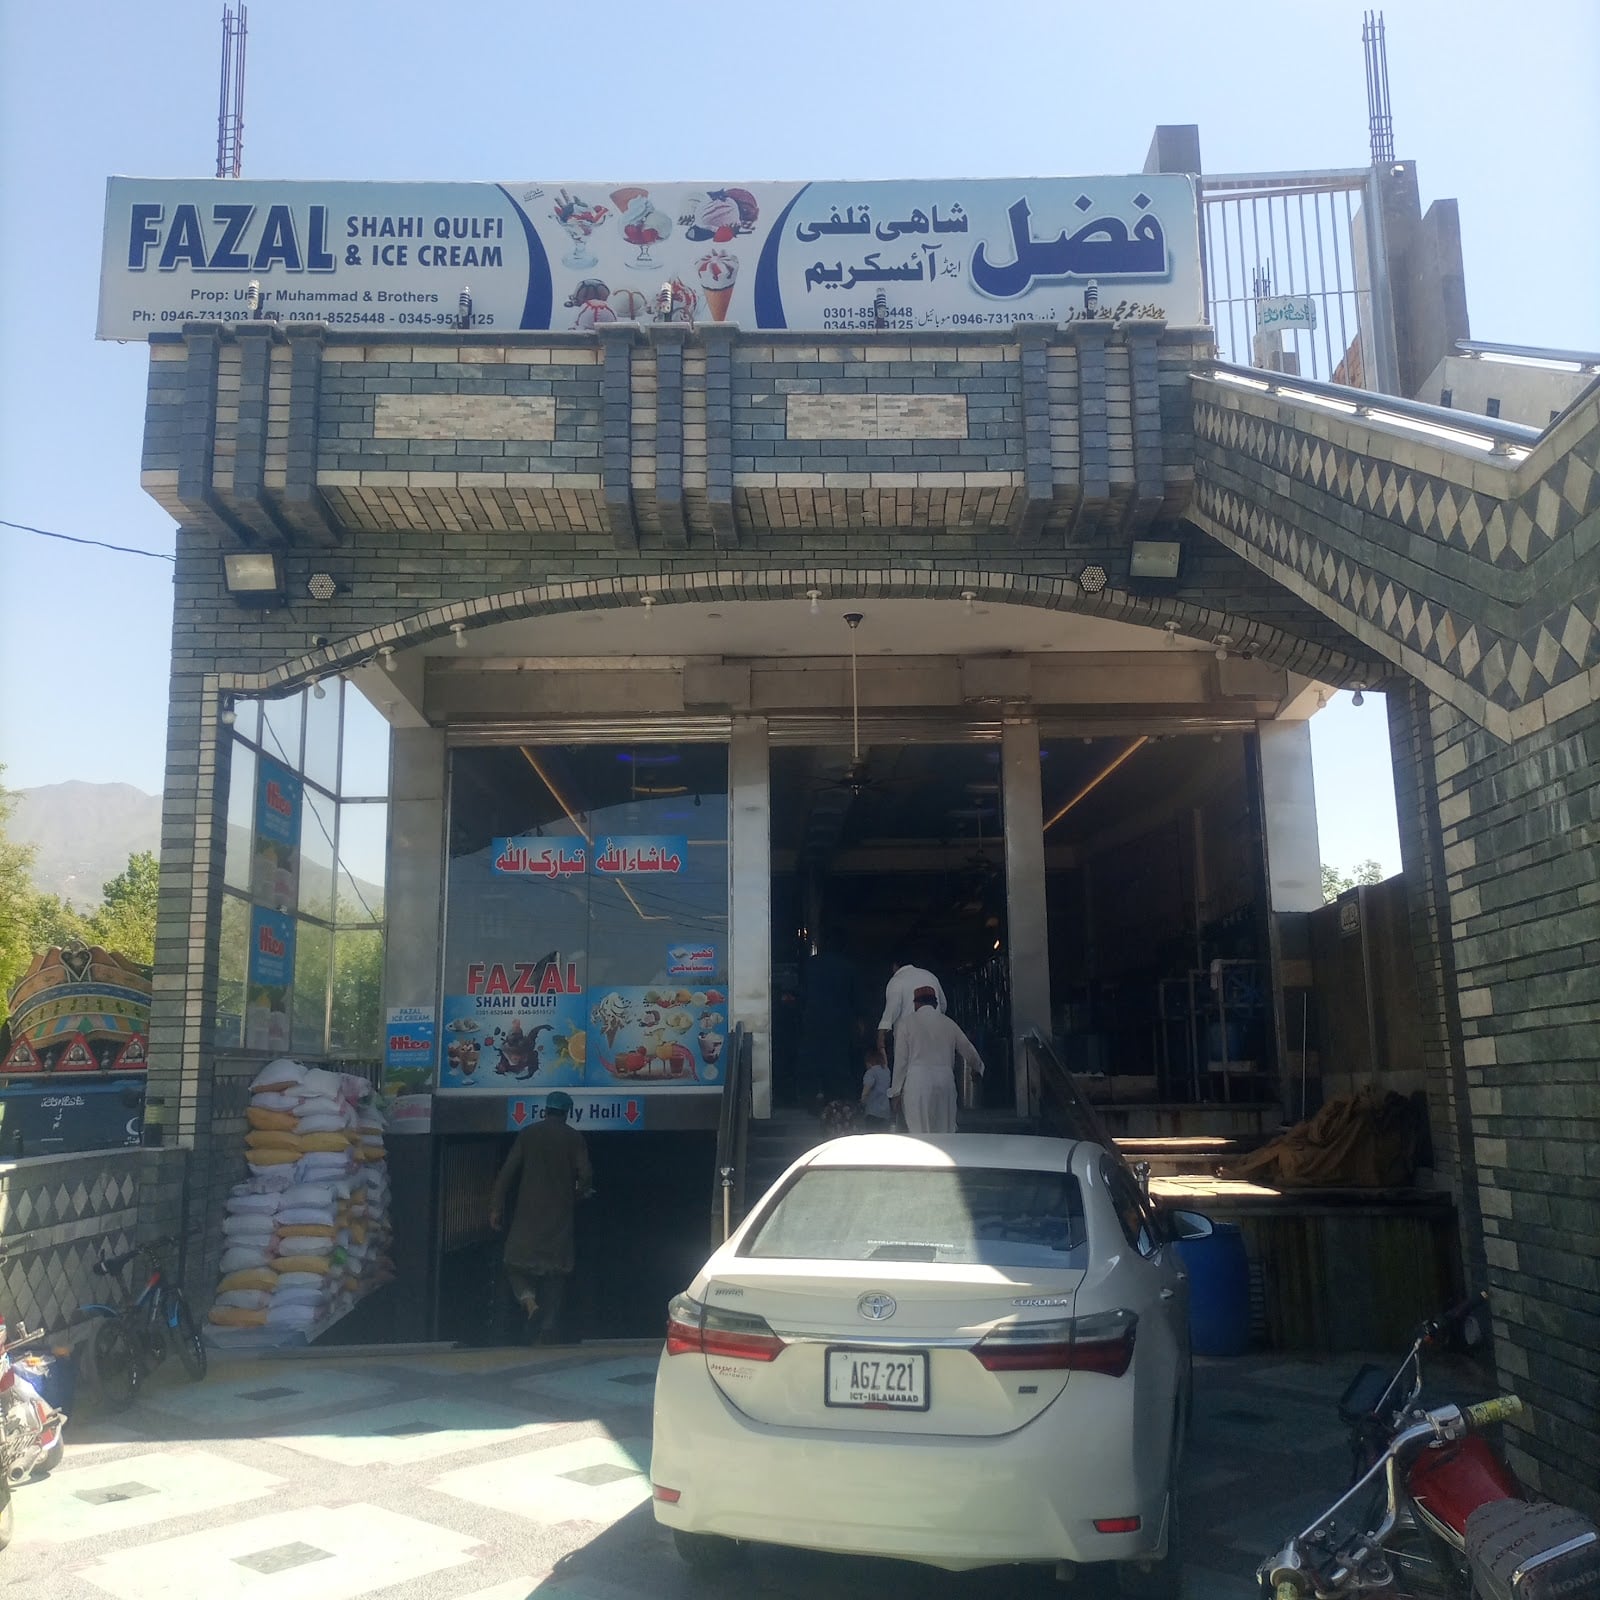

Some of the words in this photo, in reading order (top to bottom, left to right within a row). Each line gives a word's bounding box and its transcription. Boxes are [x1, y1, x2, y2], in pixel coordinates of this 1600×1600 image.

[346, 216, 423, 239] SHAHI
[434, 217, 504, 240] QULFI
[796, 203, 871, 243] قلفی
[876, 202, 969, 241] شاہی
[127, 203, 336, 271] FAZAL
[971, 193, 1168, 299] فضل
[345, 244, 362, 266] &
[372, 244, 408, 267] ICE
[418, 244, 504, 267] CREAM
[191, 289, 229, 303] Prop:
[276, 289, 358, 302] Muhammad
[363, 290, 374, 302] &
[378, 290, 439, 302] Brothers
[132, 310, 156, 321] Ph:
[398, 313, 494, 325] 0345-951125
[466, 962, 582, 995] FAZAL
[476, 996, 515, 1008] SHAHI
[521, 996, 557, 1008] QULFI
[590, 1103, 620, 1118] Hall
[850, 1361, 913, 1391] AGZ-221
[850, 1391, 919, 1402] ICT-ISLAMABAD
